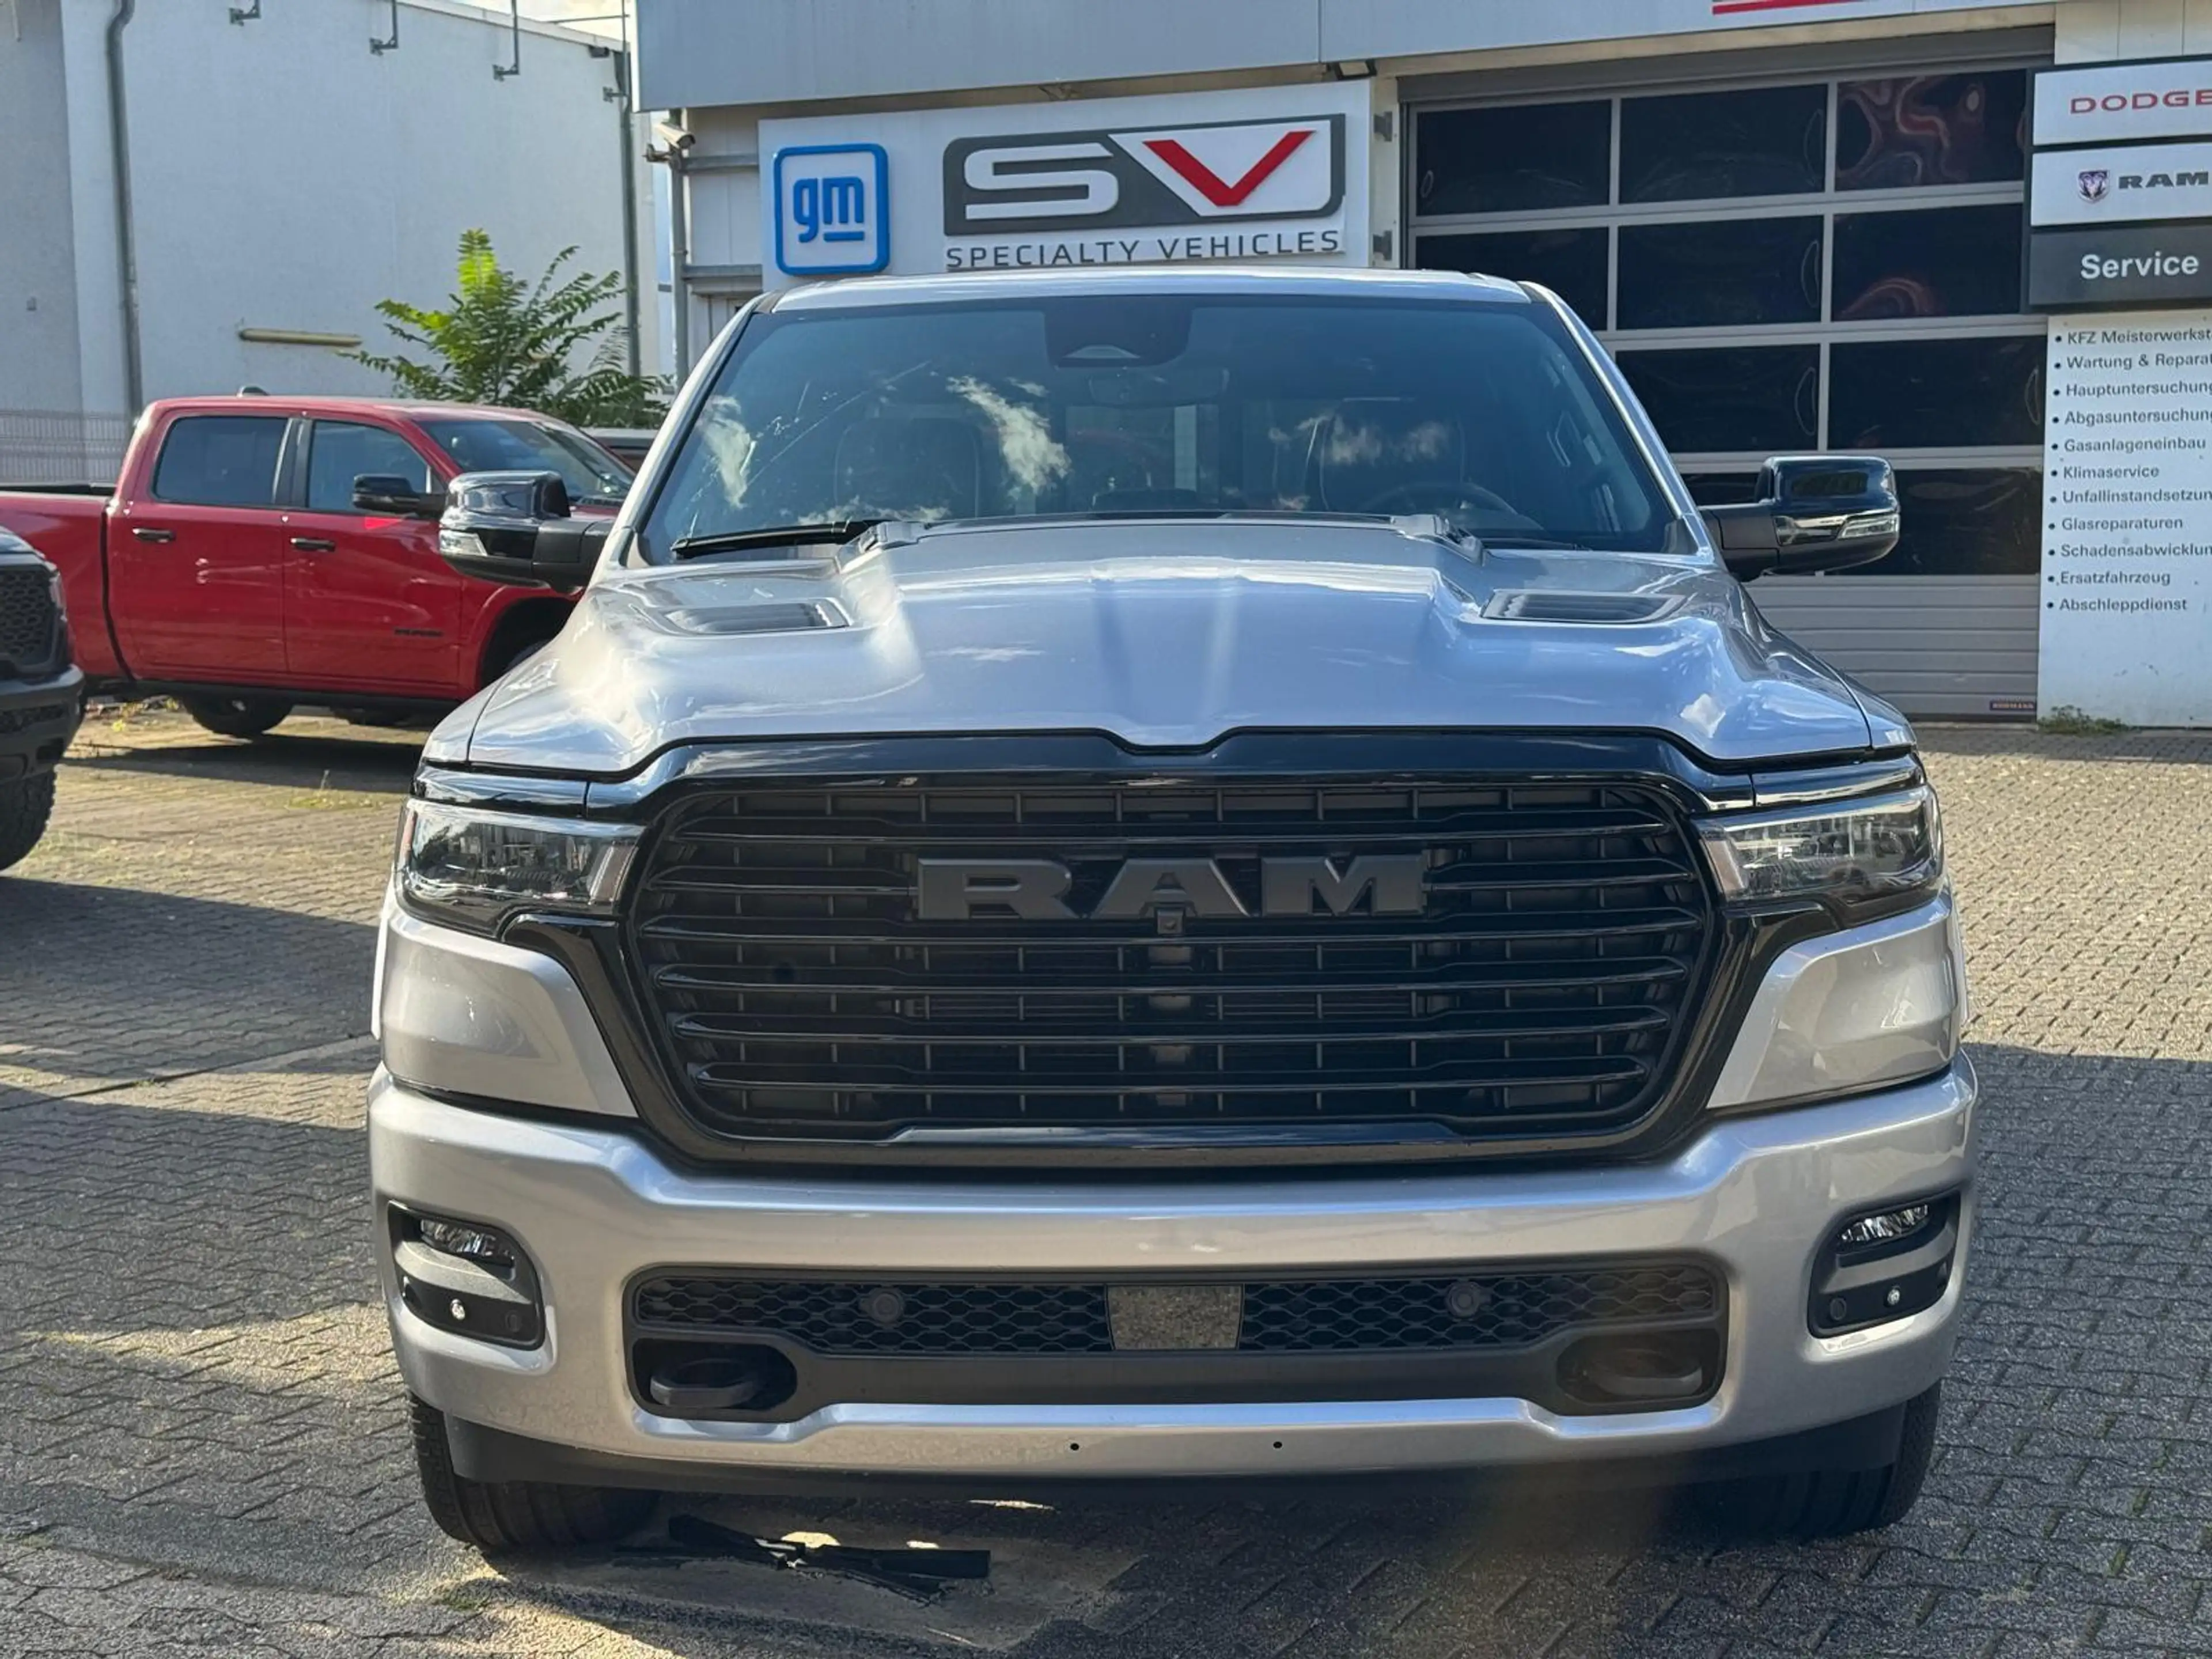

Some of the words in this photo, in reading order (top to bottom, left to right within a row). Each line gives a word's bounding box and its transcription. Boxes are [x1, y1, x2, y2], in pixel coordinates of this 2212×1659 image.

[2070, 90, 2212, 115] DODGE
[2119, 171, 2209, 190] RAM
[793, 176, 864, 243] gm
[946, 240, 1139, 268] SPECIALTY
[1157, 230, 1339, 259] VEHICLES
[2080, 251, 2199, 280] Service
[2067, 331, 2097, 344] KFZ
[2067, 355, 2133, 370] Wartung
[2138, 354, 2149, 366] &
[2065, 407, 2212, 427] Abgasuntersuchun
[2064, 436, 2206, 453] Gasanlageneinbau
[2063, 465, 2160, 479] Klimaservice
[2062, 517, 2183, 532] Glasreparaturen
[2060, 570, 2171, 586] Ersatzfahrzeug
[2059, 597, 2188, 613] Abschleppdienst
[918, 857, 1426, 920] RAM
